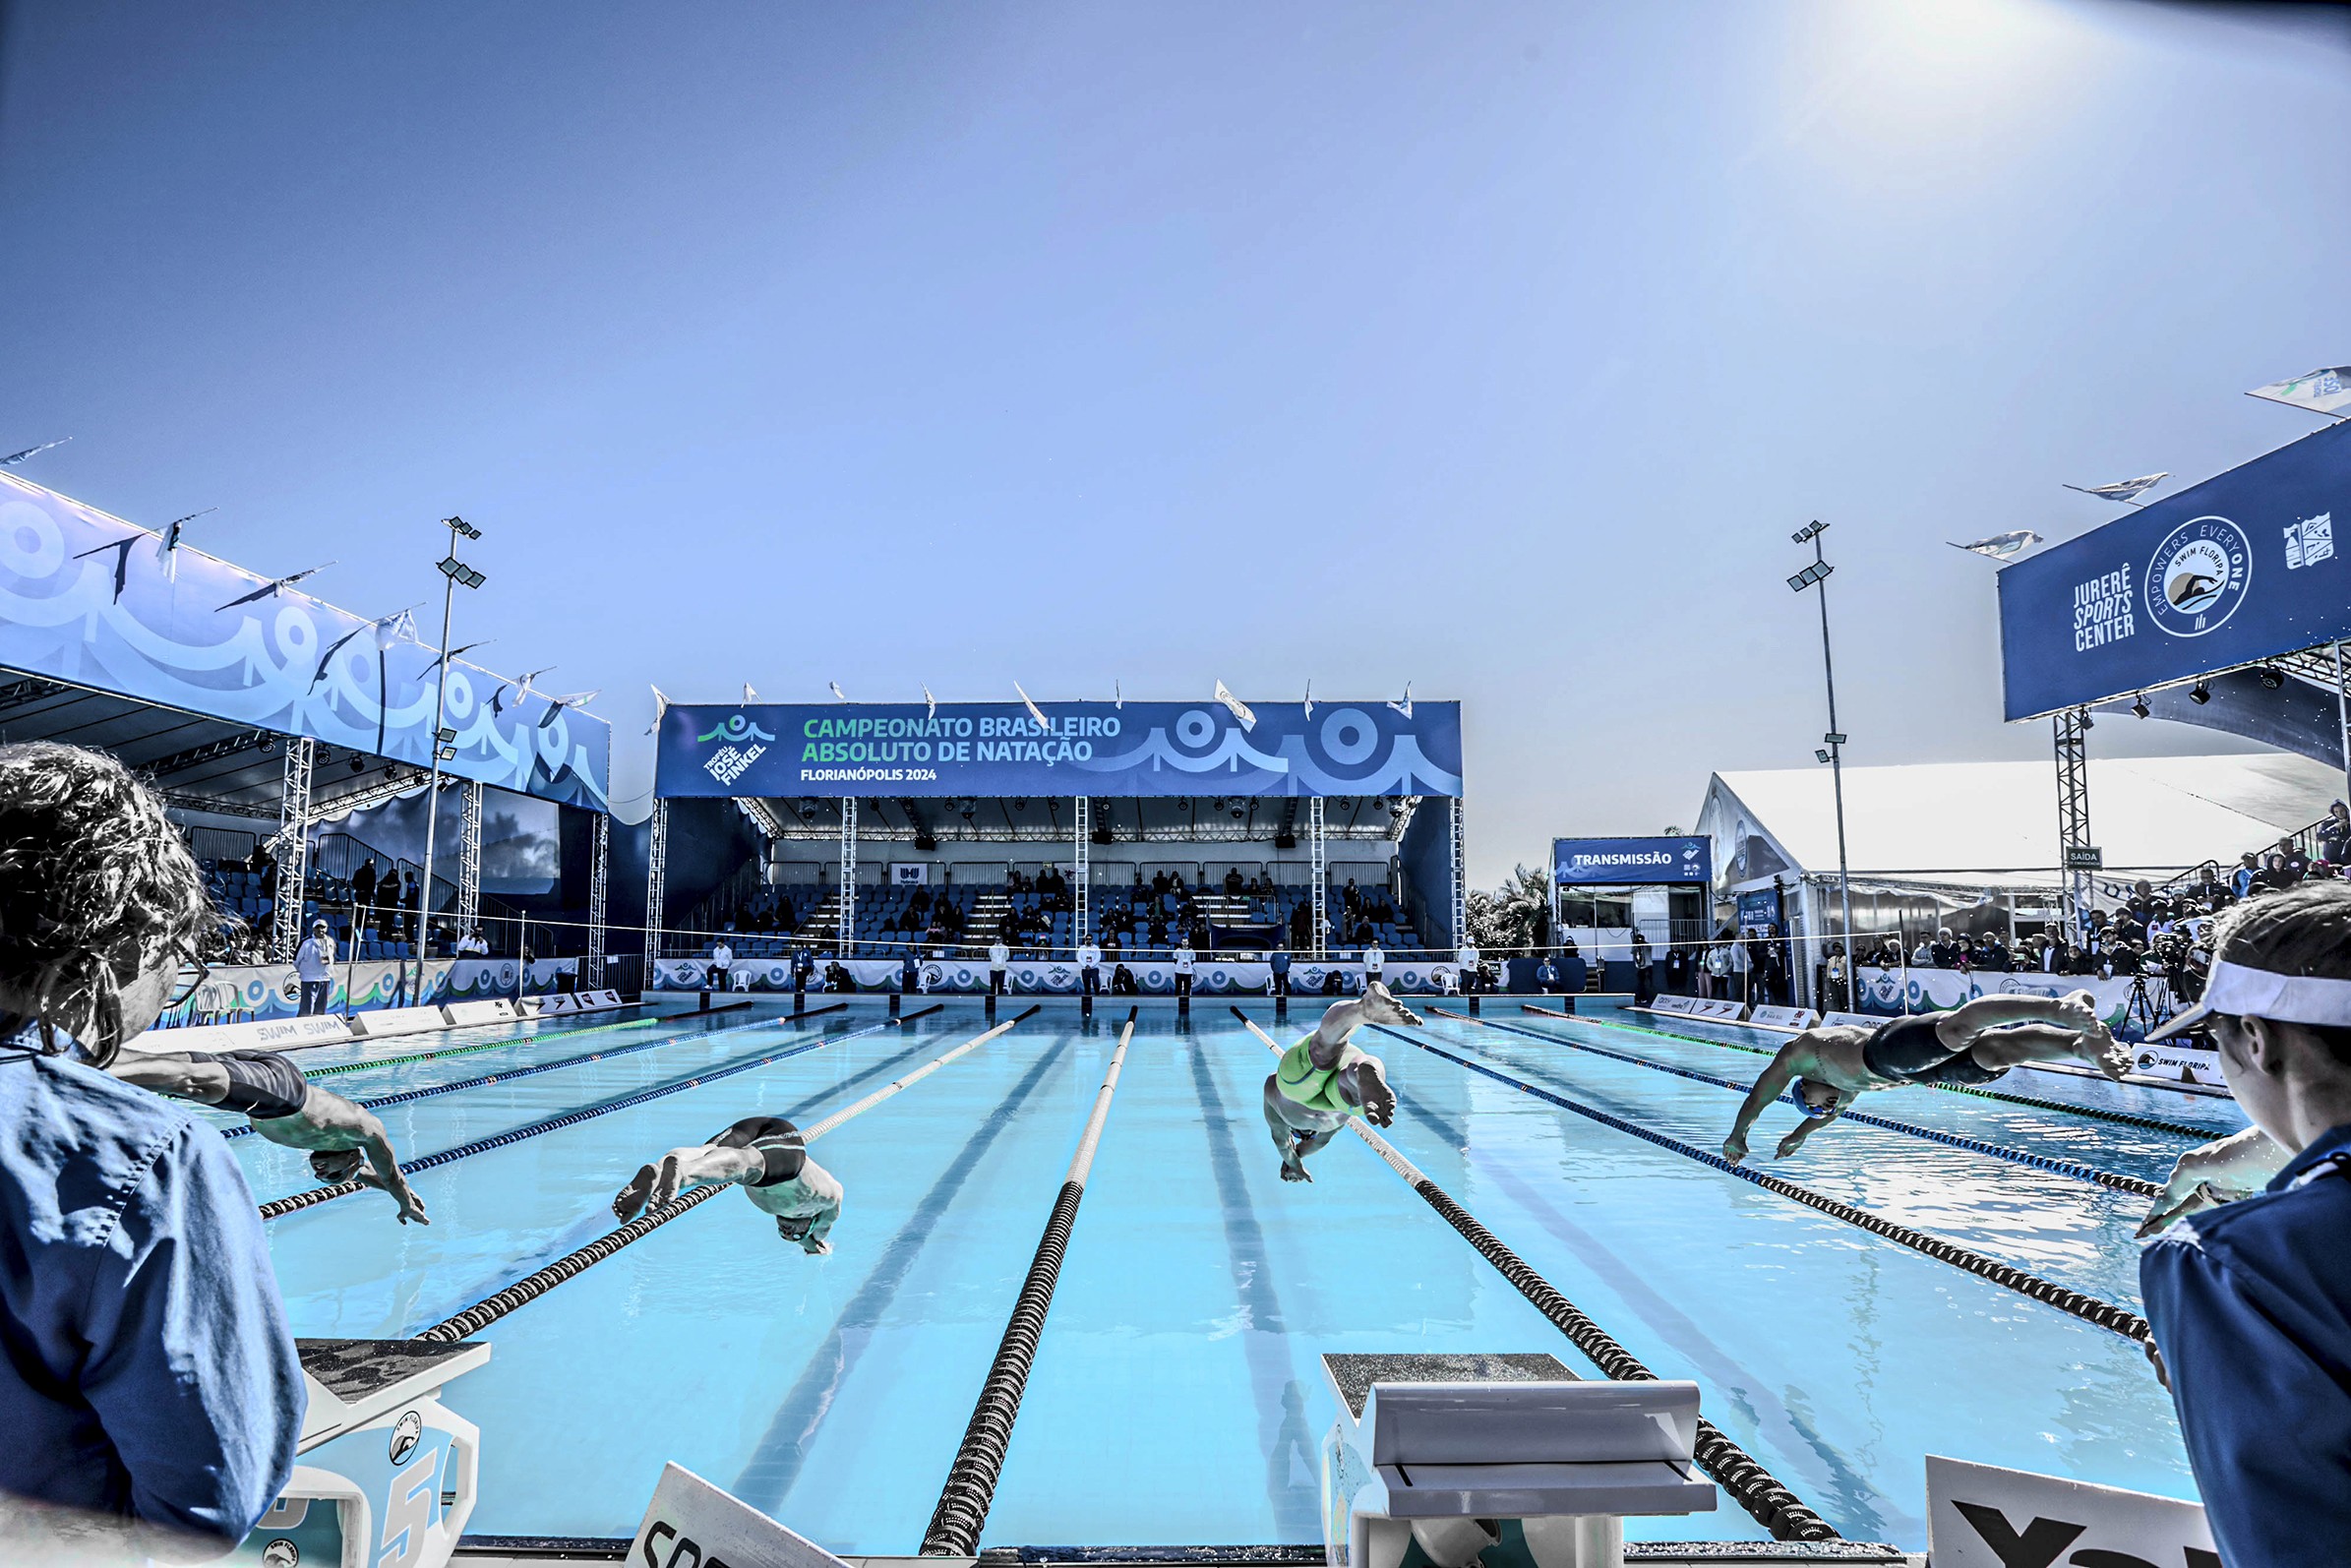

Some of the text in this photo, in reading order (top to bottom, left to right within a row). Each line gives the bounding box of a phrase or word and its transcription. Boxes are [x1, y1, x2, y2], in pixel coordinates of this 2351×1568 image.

[2151, 524, 2244, 616] EMPOWERS EVERYONE
[2175, 546, 2224, 575] SWIM FLORIPA
[2073, 562, 2132, 609] JURERÊ
[2074, 589, 2134, 630] SPORTS
[2075, 613, 2135, 652] CENTER
[804, 717, 973, 738] CAMPEONATO
[709, 746, 742, 781] JOSÉ
[720, 744, 766, 787] FINKEL
[801, 736, 1093, 767] ABSOLUTO DE NATAÇÃO
[801, 766, 936, 781] FLORIANÓPOLIS 2024
[1574, 850, 1672, 866] TRANSMISSÃO
[2070, 851, 2097, 861] SAÍDA
[257, 1020, 340, 1042] SWIM SWIM
[2158, 1057, 2178, 1067] SWIM
[376, 1446, 438, 1568] 5
